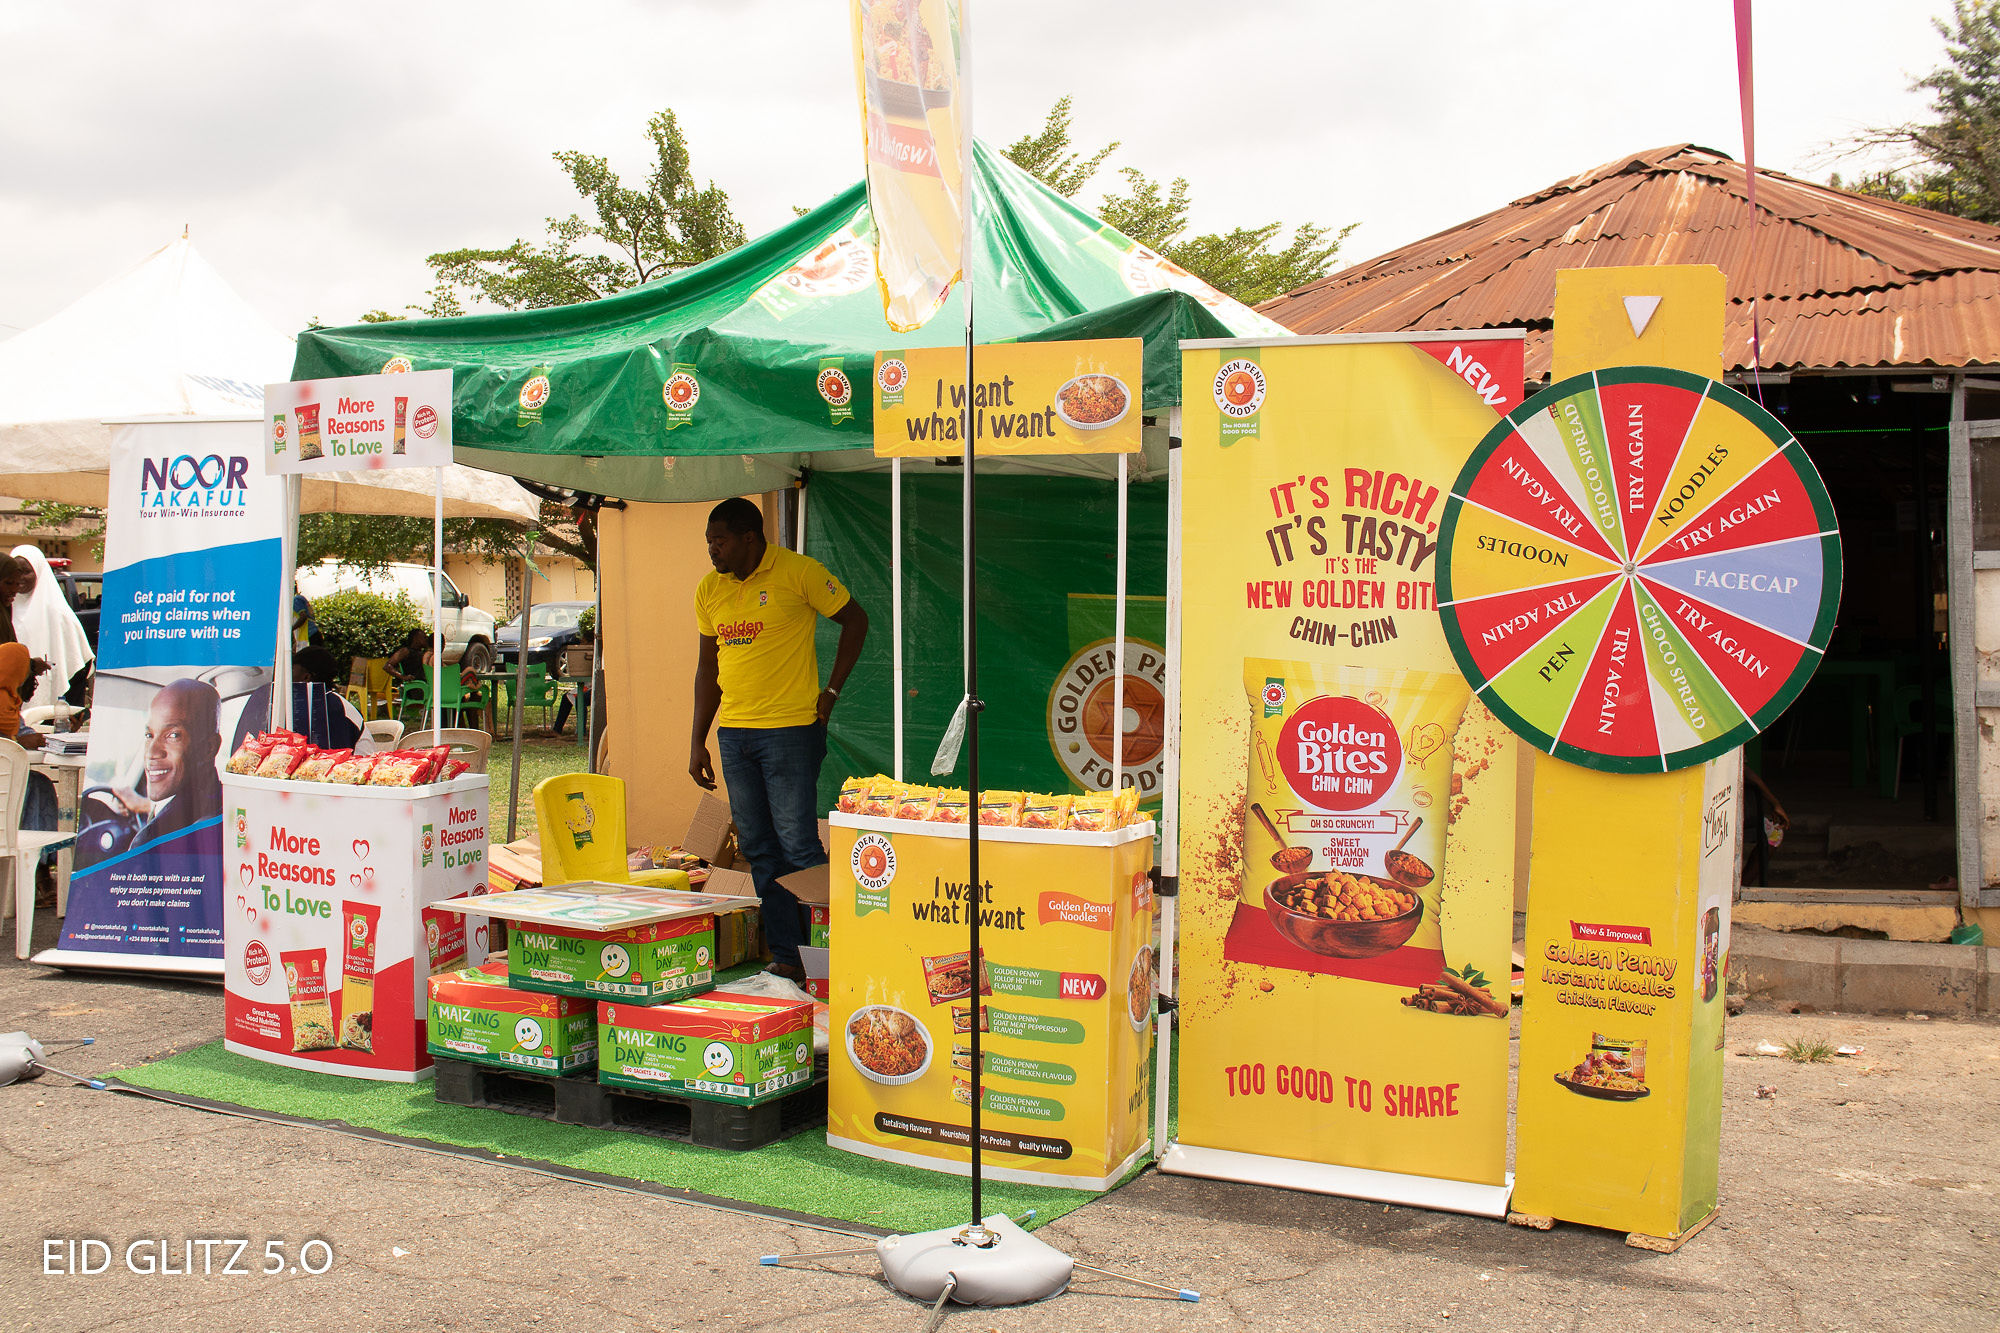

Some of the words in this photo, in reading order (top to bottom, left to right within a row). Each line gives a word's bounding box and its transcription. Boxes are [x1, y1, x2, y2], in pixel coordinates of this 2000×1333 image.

[1215, 362, 1241, 395] GOLDEN
[1244, 362, 1265, 394] PENNY
[1445, 346, 1507, 405] NEW
[937, 379, 943, 409] I
[950, 374, 1015, 408] want
[337, 397, 376, 416] More
[1223, 402, 1257, 416] FOODS
[327, 418, 386, 436] Reasons
[977, 409, 984, 440] I
[990, 405, 1057, 437] want
[1565, 403, 1594, 463] SPREAD
[330, 439, 346, 457] To
[349, 437, 383, 456] Love
[1628, 404, 1645, 470] AGAIN
[141, 453, 249, 492] NOOR
[1500, 456, 1555, 506] AGAIN
[1628, 473, 1645, 514] TRY
[1656, 443, 1730, 527] NOODLES
[140, 489, 247, 508] TAKAFUL
[1270, 475, 1331, 519] IT'S
[1586, 466, 1616, 530] CHOCO
[139, 509, 158, 519] Your
[159, 508, 199, 519] Win-Win
[200, 507, 246, 518] Insurance
[1548, 503, 1583, 537] TRY
[1675, 522, 1717, 554] TRY
[1718, 489, 1783, 534] AGAIN
[1265, 514, 1328, 567] IT'S
[1476, 535, 1569, 567] NOODLES
[1325, 556, 1350, 575] IT'S
[1354, 558, 1378, 575] THE
[1693, 568, 1799, 595] FACECAP
[134, 590, 154, 605] Get
[156, 589, 187, 606] paid
[189, 589, 211, 604] for
[212, 590, 237, 604] not
[1246, 580, 1293, 610] NEW
[1302, 580, 1386, 610] GOLDEN
[1544, 591, 1581, 617] TRY
[121, 608, 162, 625] making
[164, 608, 210, 622] claims
[211, 607, 252, 622] when
[1481, 608, 1540, 647] AGAIN
[124, 628, 143, 645] you
[145, 626, 188, 640] insure
[191, 625, 220, 640] with
[222, 628, 242, 640] us
[716, 620, 765, 636] Golden
[1289, 615, 1398, 648] CHIN-CHIN
[1611, 627, 1632, 667] TRY
[1674, 599, 1711, 633] TRY
[1707, 627, 1770, 681] AGAIN
[1537, 642, 1577, 684] PEN
[1642, 603, 1676, 665] CHOCO
[1669, 667, 1707, 731] SPREAD
[1598, 669, 1622, 736] AGAIN
[1297, 720, 1386, 755] Golden
[1297, 741, 1389, 776] Bites
[1311, 774, 1340, 793] CHIN
[1344, 776, 1373, 796] CHIN
[449, 806, 478, 827] More
[1310, 819, 1322, 830] OH
[1323, 819, 1335, 830] SO
[1335, 818, 1376, 831] CRUNCHY!
[269, 825, 321, 857] More
[439, 825, 485, 848] Reasons
[1330, 837, 1362, 848] SWEET
[258, 852, 336, 887] Reasons
[442, 849, 459, 870] To
[457, 848, 484, 868] Love
[1330, 857, 1365, 869] FLAVOR
[110, 873, 127, 882] Have
[132, 873, 148, 883] both
[148, 875, 164, 885] ways
[164, 874, 180, 883] with
[192, 875, 206, 884] and
[934, 876, 940, 899] I
[110, 886, 128, 897] enjoy
[128, 886, 153, 897] surplus
[153, 888, 183, 898] payment
[182, 887, 202, 896] when
[261, 883, 281, 912] To
[285, 887, 332, 919] Love
[117, 899, 130, 908] you
[149, 900, 166, 908] make
[166, 899, 191, 909] claims
[912, 900, 960, 925] what
[964, 902, 970, 926] I
[978, 906, 1026, 931] want
[1048, 899, 1081, 915] Golden
[1083, 902, 1114, 917] Penny
[1060, 910, 1099, 923] Noodles
[515, 931, 586, 956] AMAIZING
[1578, 924, 1599, 935] New
[1598, 927, 1606, 936] &
[1605, 928, 1643, 942] Improved
[522, 950, 550, 968] DAY
[1543, 938, 1613, 970] Golden
[1615, 946, 1678, 982] Penny
[993, 967, 1019, 977] GOLDEN
[1019, 969, 1041, 979] PENNY
[993, 974, 1015, 984] JOLLOF
[1015, 977, 1028, 986] HOT
[1029, 979, 1043, 987] HOT
[1541, 965, 1606, 991] Instant
[1607, 974, 1676, 999] Noodles
[993, 982, 1023, 992] FLAVOUR
[1062, 977, 1098, 997] NEW
[1556, 988, 1607, 1009] Chicken
[1607, 994, 1656, 1016] Flavour
[432, 1003, 500, 1029] AMAIZING
[993, 1011, 1018, 1021] GOLDEN
[1018, 1014, 1039, 1024] PENNY
[1010, 1021, 1028, 1030] MEAT
[1028, 1023, 1069, 1034] PEPPERSOUP
[438, 1021, 463, 1040] DAY
[607, 1027, 687, 1054] AMAIZING
[993, 1026, 1024, 1036] FLAVOUR
[615, 1046, 645, 1066] DAY
[991, 1057, 1017, 1067] GOLDEN
[1017, 1060, 1039, 1070] PENNY
[991, 1065, 1012, 1074] JOLLOF
[1013, 1067, 1042, 1078] CHICKEN
[1042, 1071, 1074, 1082] FLAVOUR
[989, 1094, 1016, 1104] GOLDEN
[1016, 1097, 1040, 1107] PENNY
[1225, 1063, 1266, 1097] TOO
[1277, 1064, 1334, 1104] GOOD
[1345, 1075, 1372, 1112] TO
[1384, 1083, 1461, 1118] SHARE
[939, 1128, 971, 1142] Nourishing
[989, 1136, 1012, 1147] Protein
[1018, 1140, 1042, 1154] Quality
[1042, 1143, 1064, 1155] Wheat
